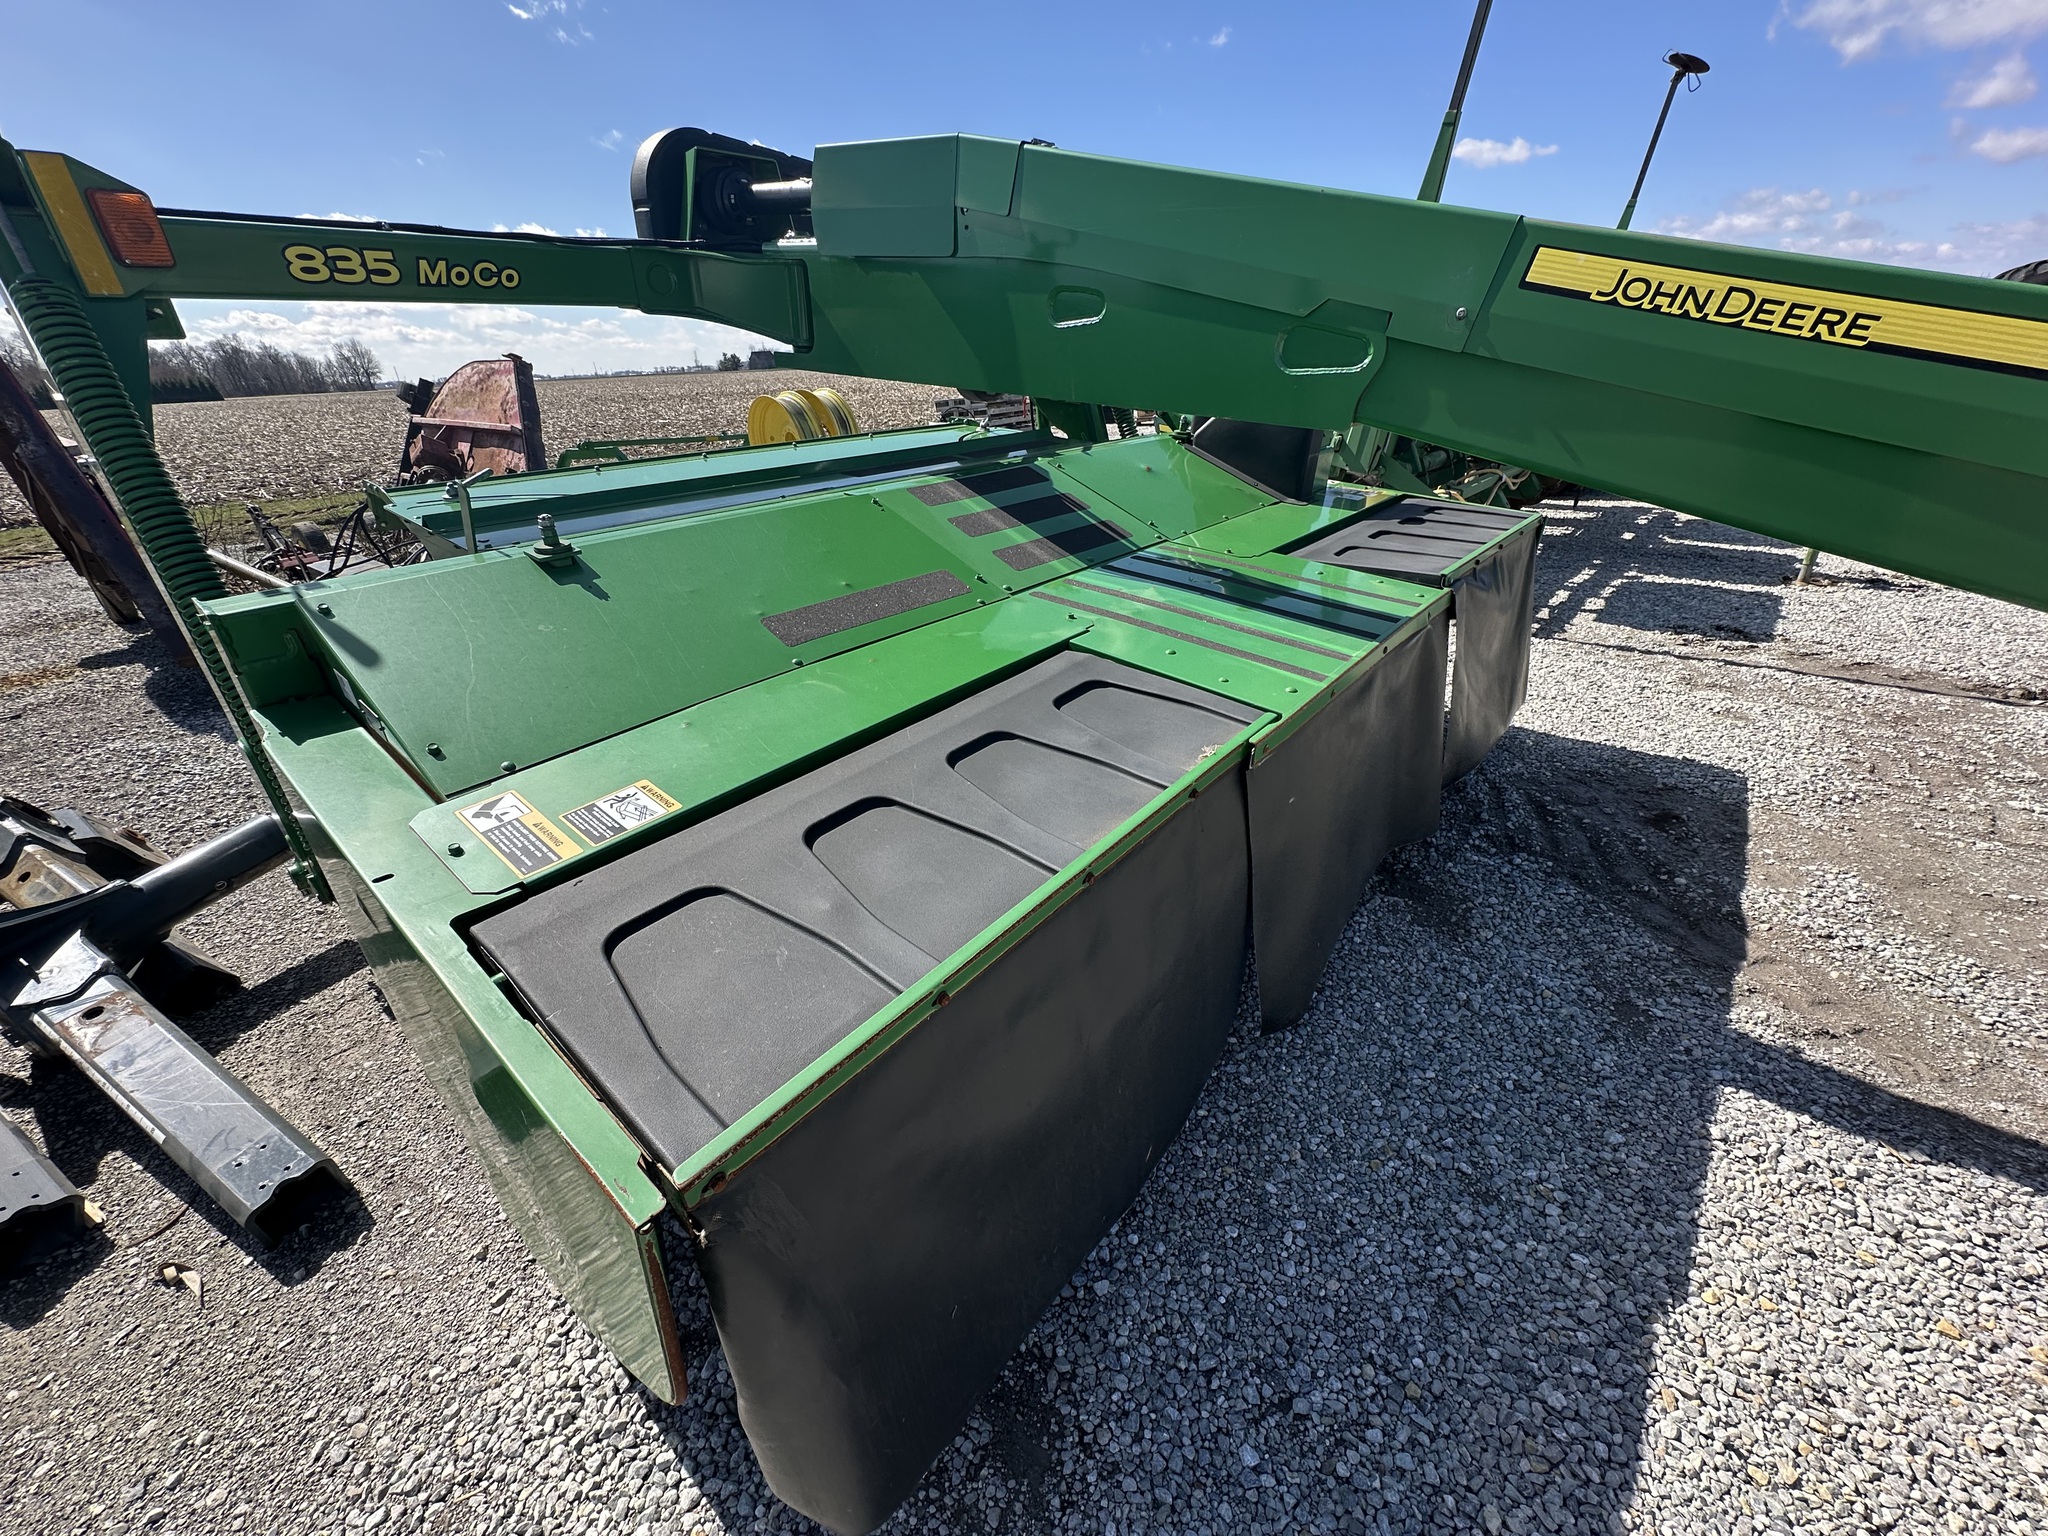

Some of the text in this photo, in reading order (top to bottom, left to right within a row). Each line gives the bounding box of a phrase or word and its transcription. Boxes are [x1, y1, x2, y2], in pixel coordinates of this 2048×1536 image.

[284, 245, 520, 288] 835 MoCo
[1593, 268, 1883, 344] JOHN DEERE
[645, 787, 675, 808] WARNING
[536, 824, 565, 847] WARNING
